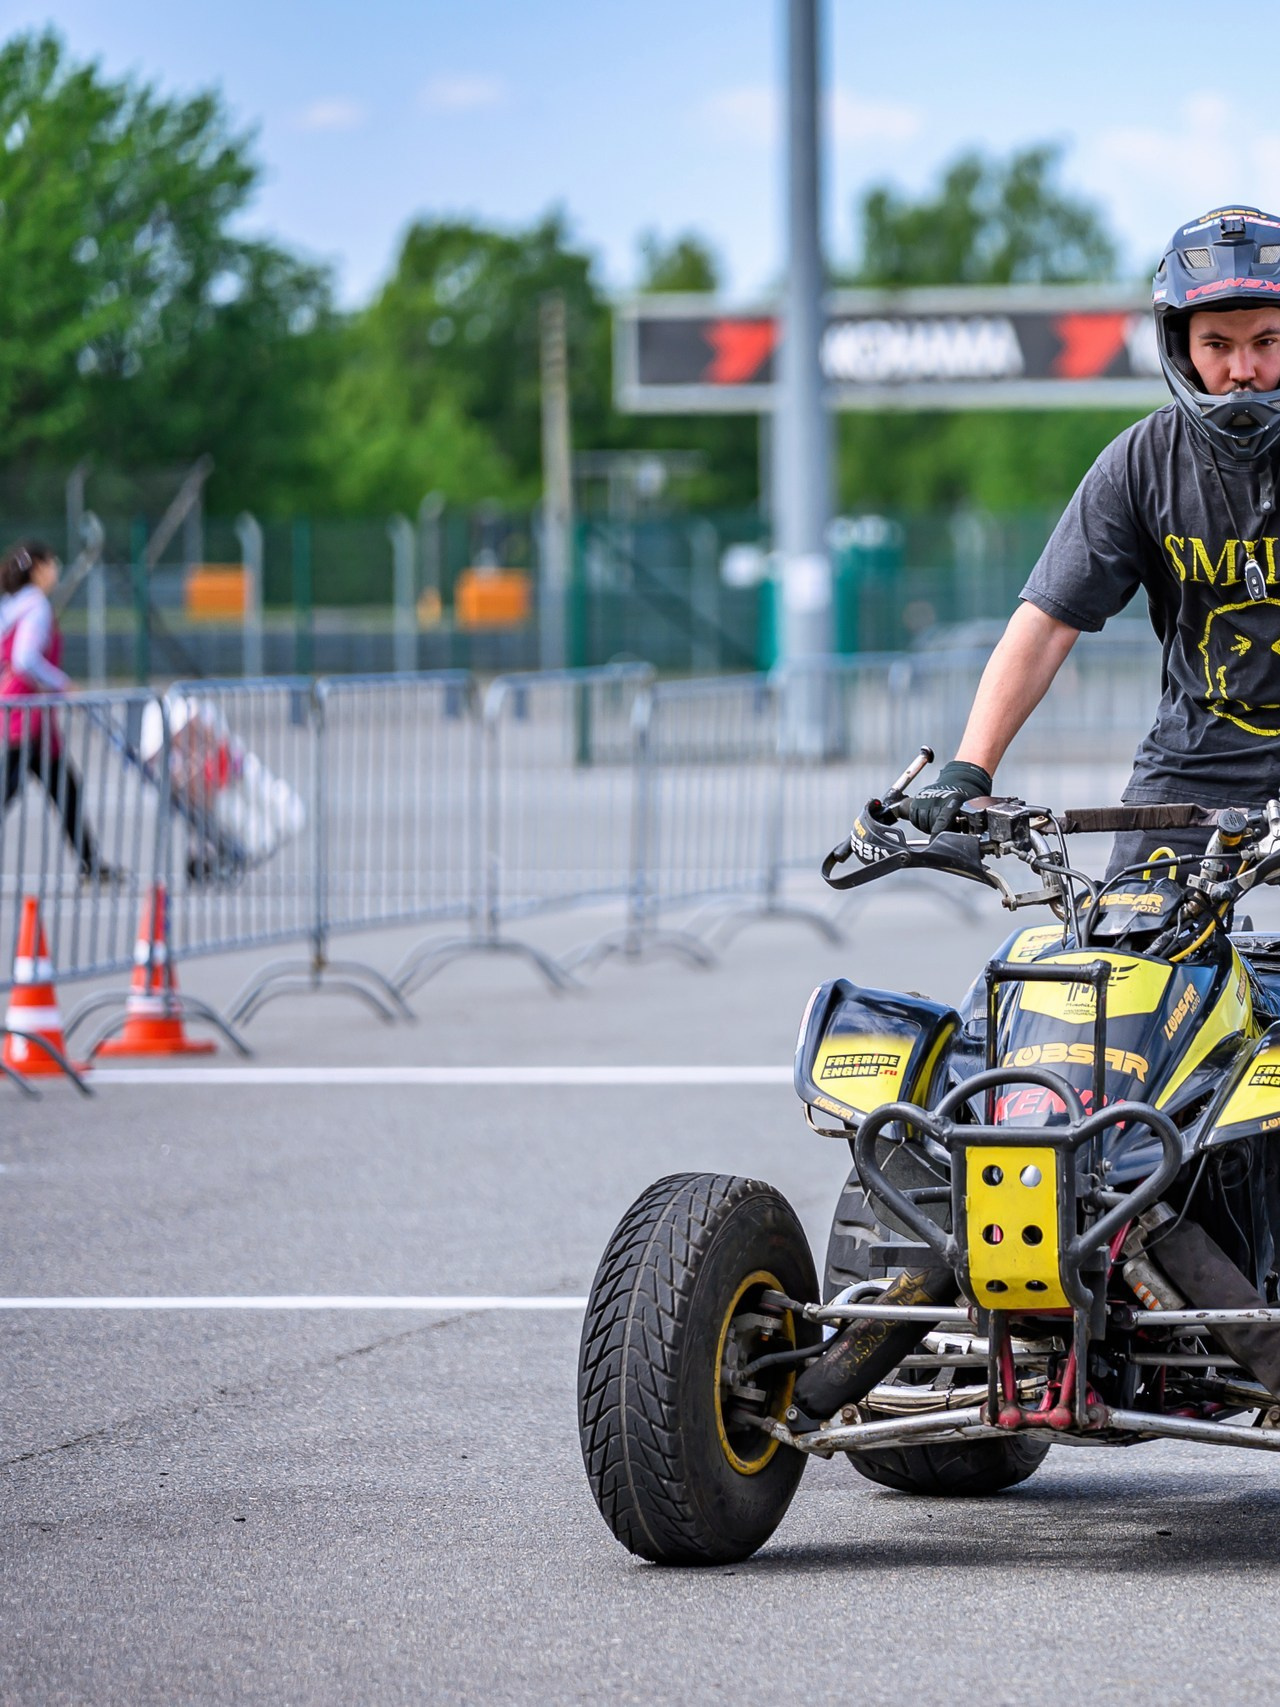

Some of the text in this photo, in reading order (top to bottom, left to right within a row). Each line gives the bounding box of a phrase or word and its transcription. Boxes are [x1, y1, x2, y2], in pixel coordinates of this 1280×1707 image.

[1131, 904, 1161, 914] MOTO
[1164, 982, 1200, 1042] LUBSAR
[1002, 1042, 1150, 1083] LUBSAR
[813, 1096, 854, 1120] LUBSAR
